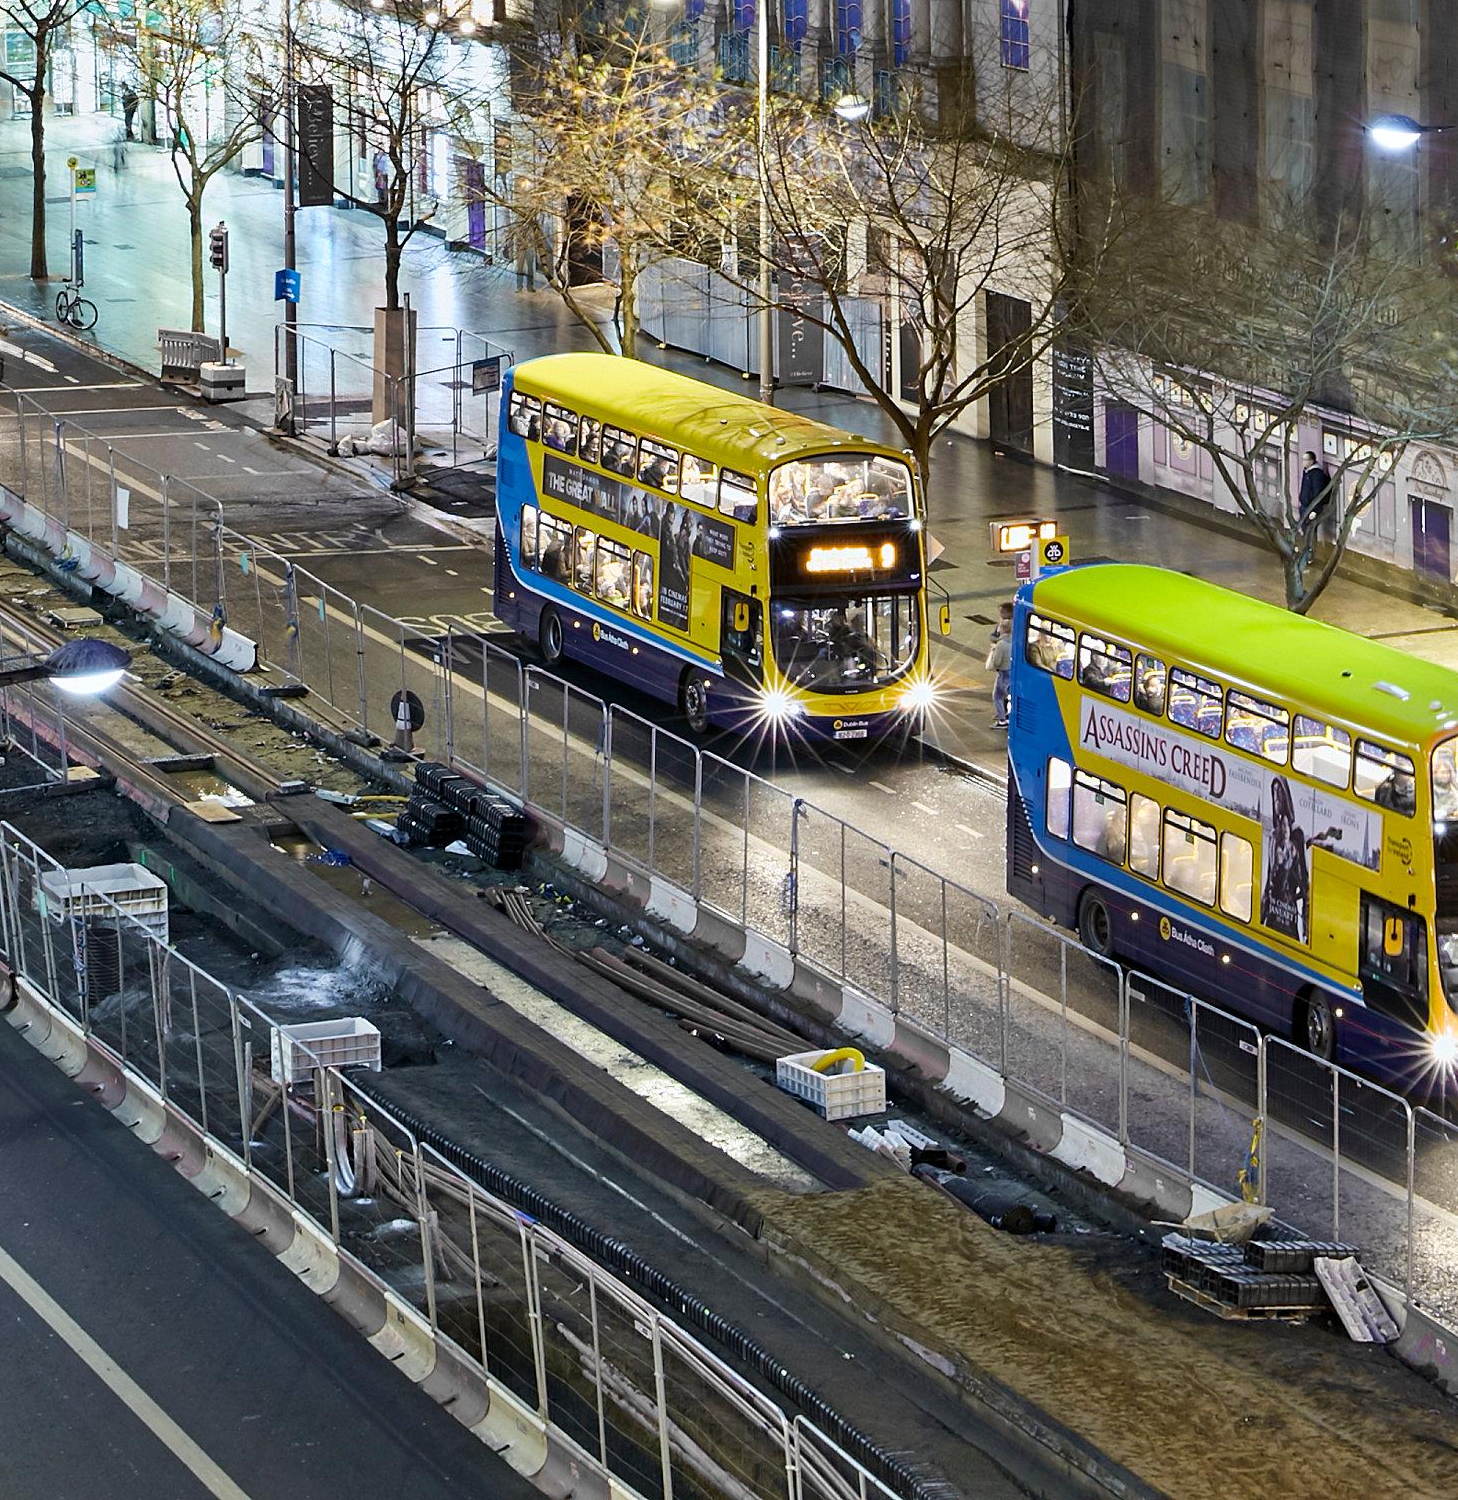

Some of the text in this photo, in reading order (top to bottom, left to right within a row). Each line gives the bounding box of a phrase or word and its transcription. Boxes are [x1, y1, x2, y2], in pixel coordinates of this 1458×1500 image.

[549, 471, 617, 513] THE GREAT WALL
[1171, 744, 1227, 799] CREED
[1171, 926, 1183, 942] Bus
